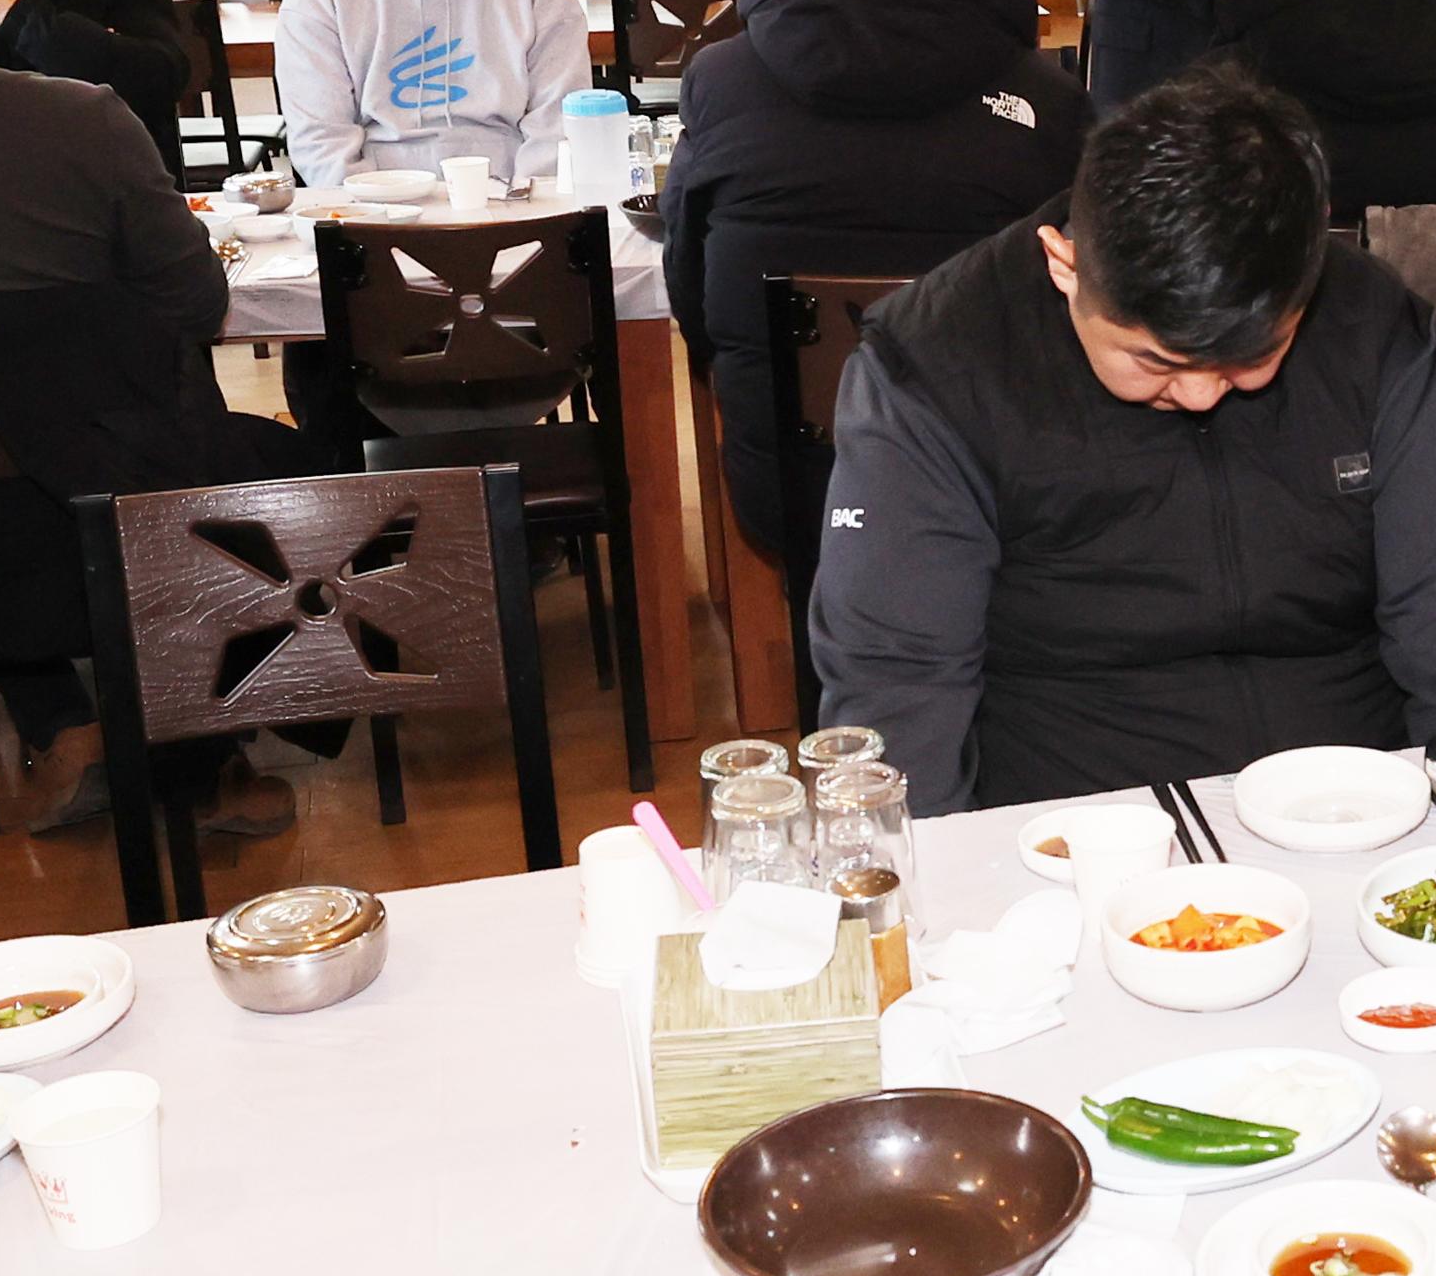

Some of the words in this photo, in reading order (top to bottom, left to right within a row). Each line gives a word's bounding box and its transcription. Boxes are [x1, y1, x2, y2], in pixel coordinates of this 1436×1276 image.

[982, 95, 1019, 113] NORTH
[998, 91, 1020, 105] THE
[992, 106, 1020, 121] FACE
[830, 507, 865, 529] BAC
